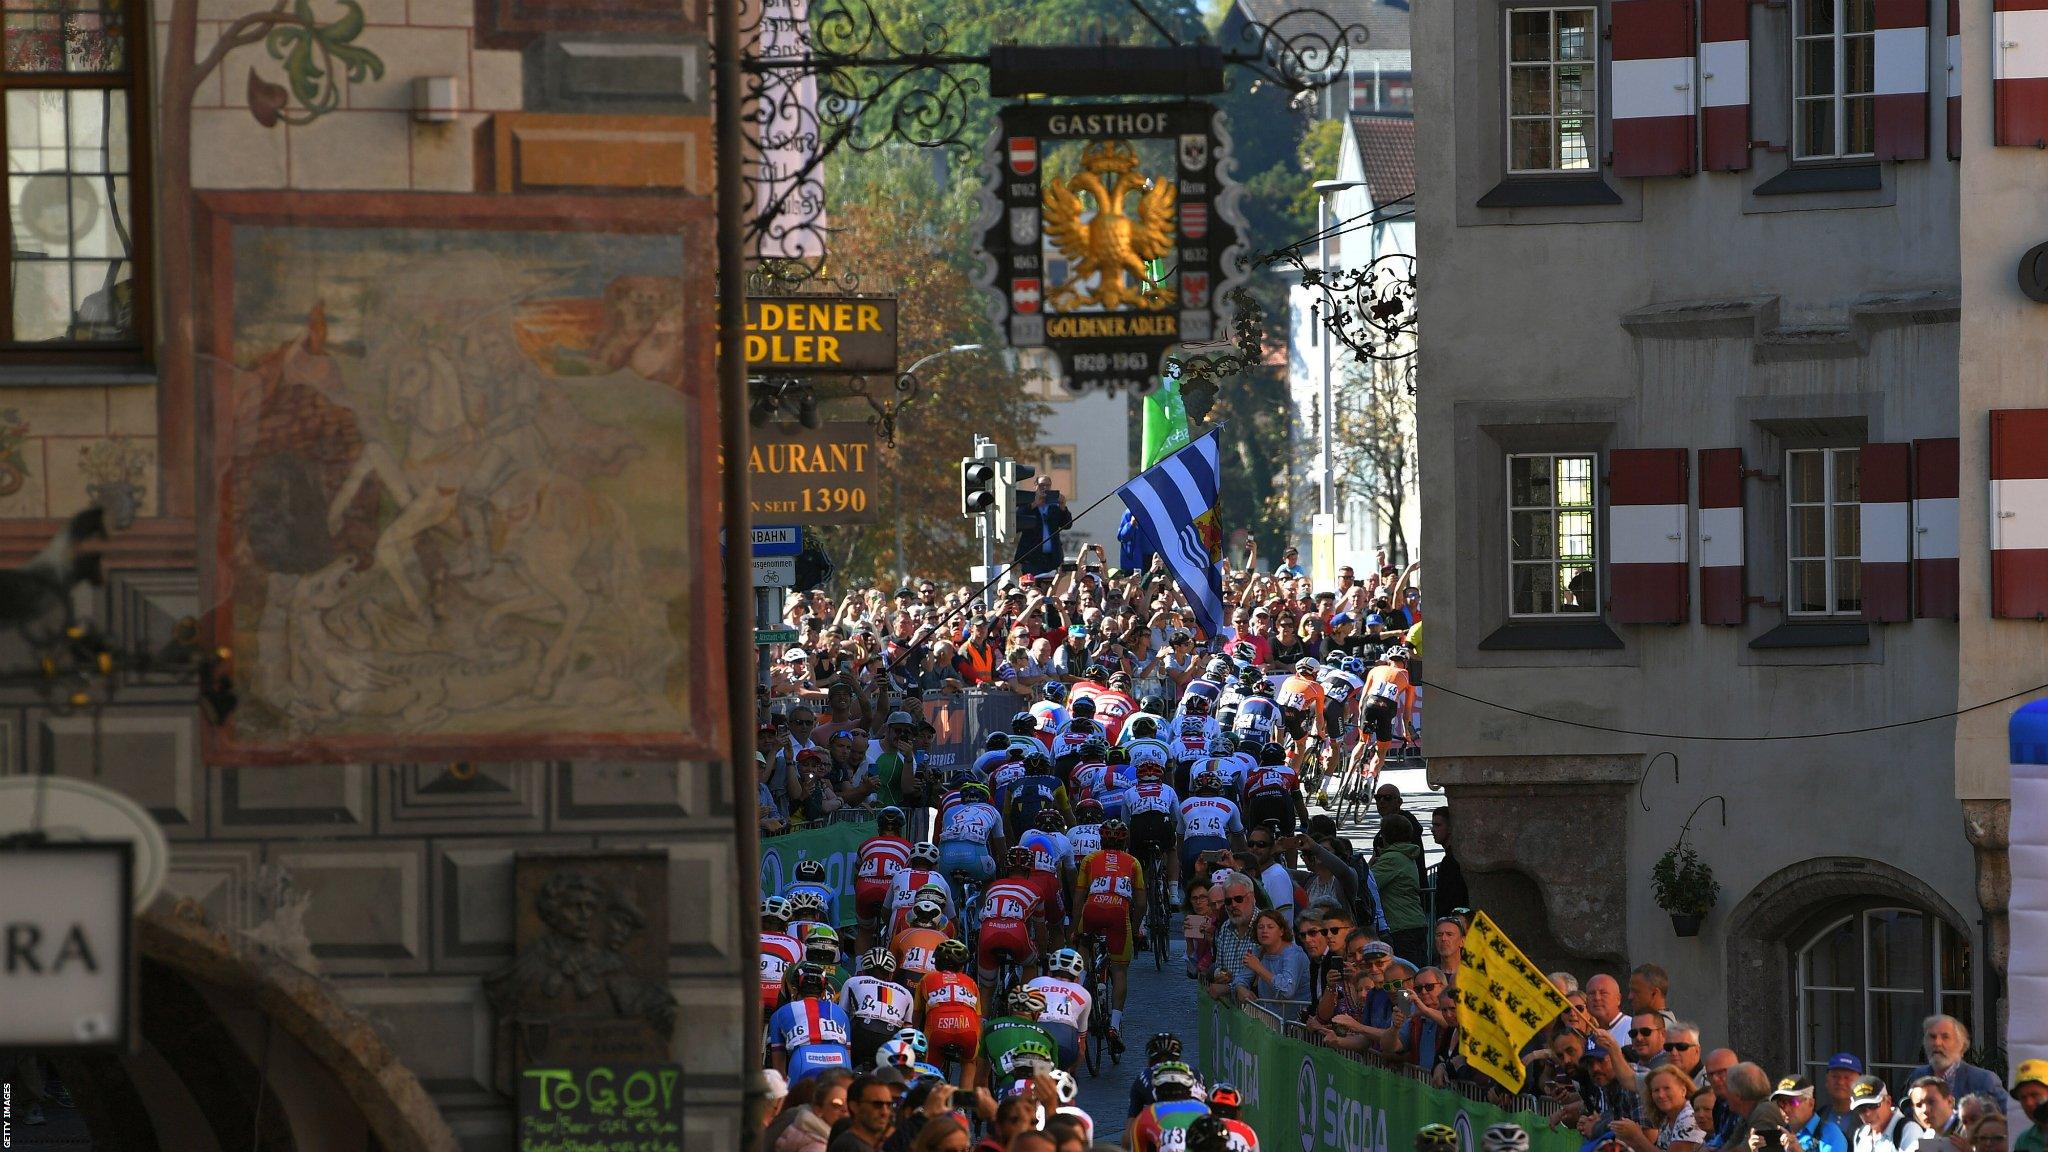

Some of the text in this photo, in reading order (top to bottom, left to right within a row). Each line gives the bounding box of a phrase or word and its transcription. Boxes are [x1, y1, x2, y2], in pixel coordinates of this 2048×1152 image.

[1049, 113, 1168, 134] GASTHOF
[714, 303, 882, 332] LDENER
[1046, 317, 1127, 338] GOLDENER
[1128, 316, 1176, 336] ADLER
[714, 335, 842, 363] DLER
[718, 443, 868, 474] AURANT
[765, 501, 798, 513] SEIT
[802, 487, 867, 512] 1390
[752, 529, 787, 544] NBAHN
[753, 559, 793, 569] usgenommen
[1194, 800, 1218, 808] GBR
[1187, 817, 1221, 831] 45 45
[898, 890, 912, 901] 95
[861, 997, 901, 1018] 84 84
[1056, 1003, 1069, 1016] 41
[937, 1014, 970, 1029] ESPAÑA
[993, 1022, 1045, 1034] IRELAND
[1322, 1072, 1388, 1152] ŠKODA
